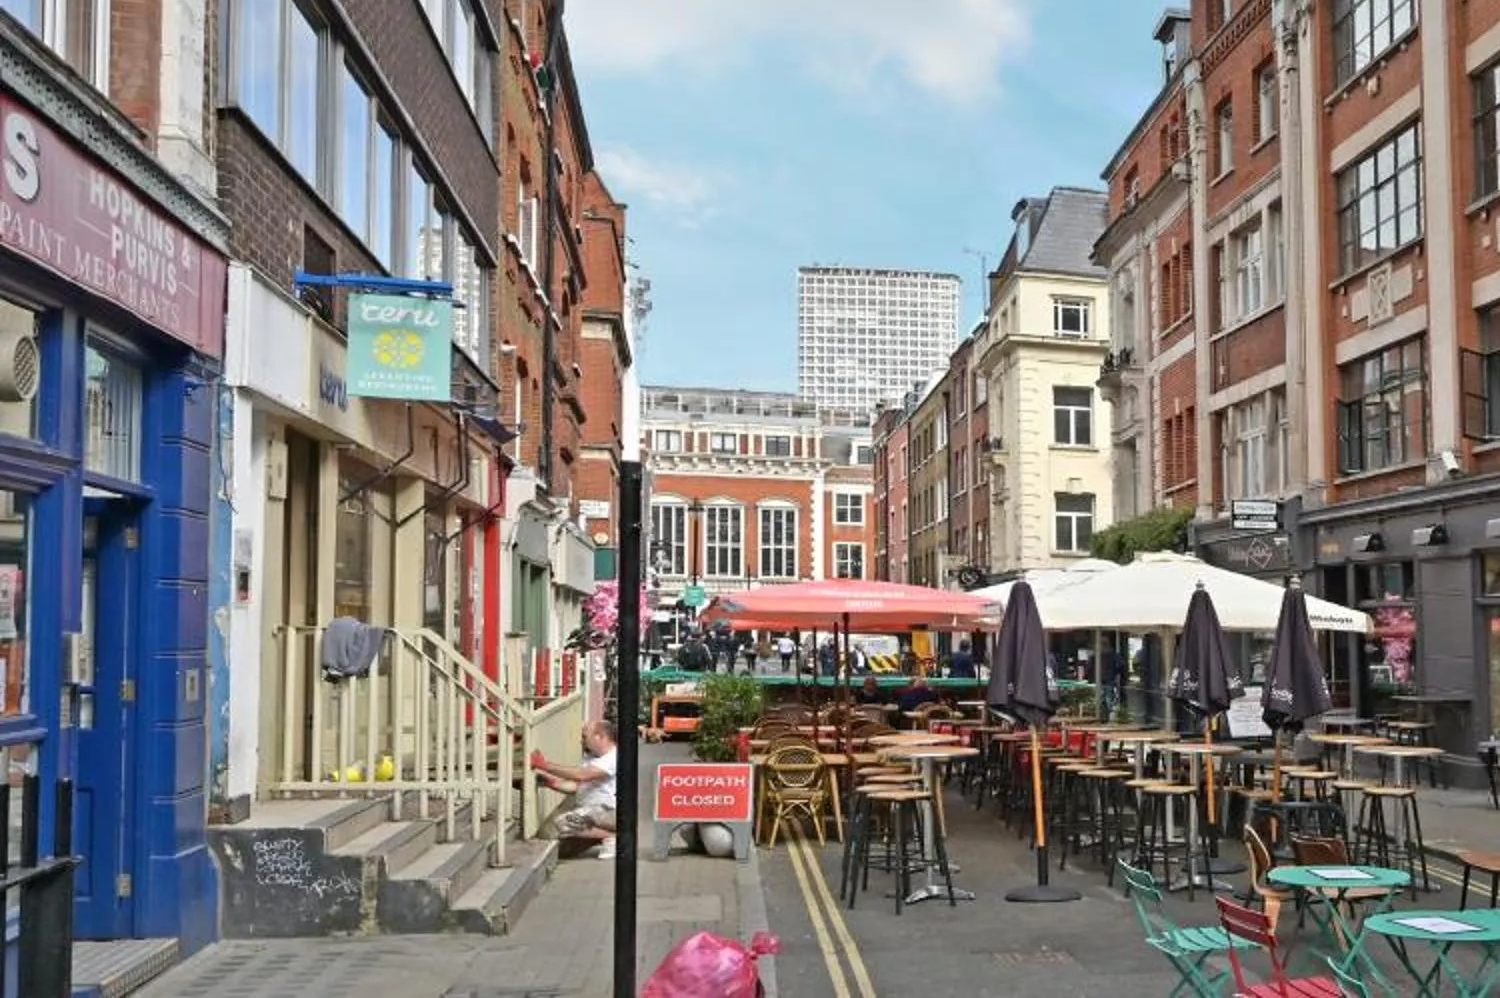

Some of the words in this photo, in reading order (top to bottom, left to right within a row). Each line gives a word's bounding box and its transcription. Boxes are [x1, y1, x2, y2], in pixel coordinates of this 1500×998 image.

[3, 112, 41, 202] S
[0, 205, 65, 266] PAINT
[89, 169, 175, 256] HOPKINS
[181, 238, 193, 273] &
[74, 247, 181, 329] MERCHANTS
[110, 224, 177, 296] PURVIS
[662, 775, 745, 787] FOOTPATH
[671, 795, 735, 806] CLOSED
